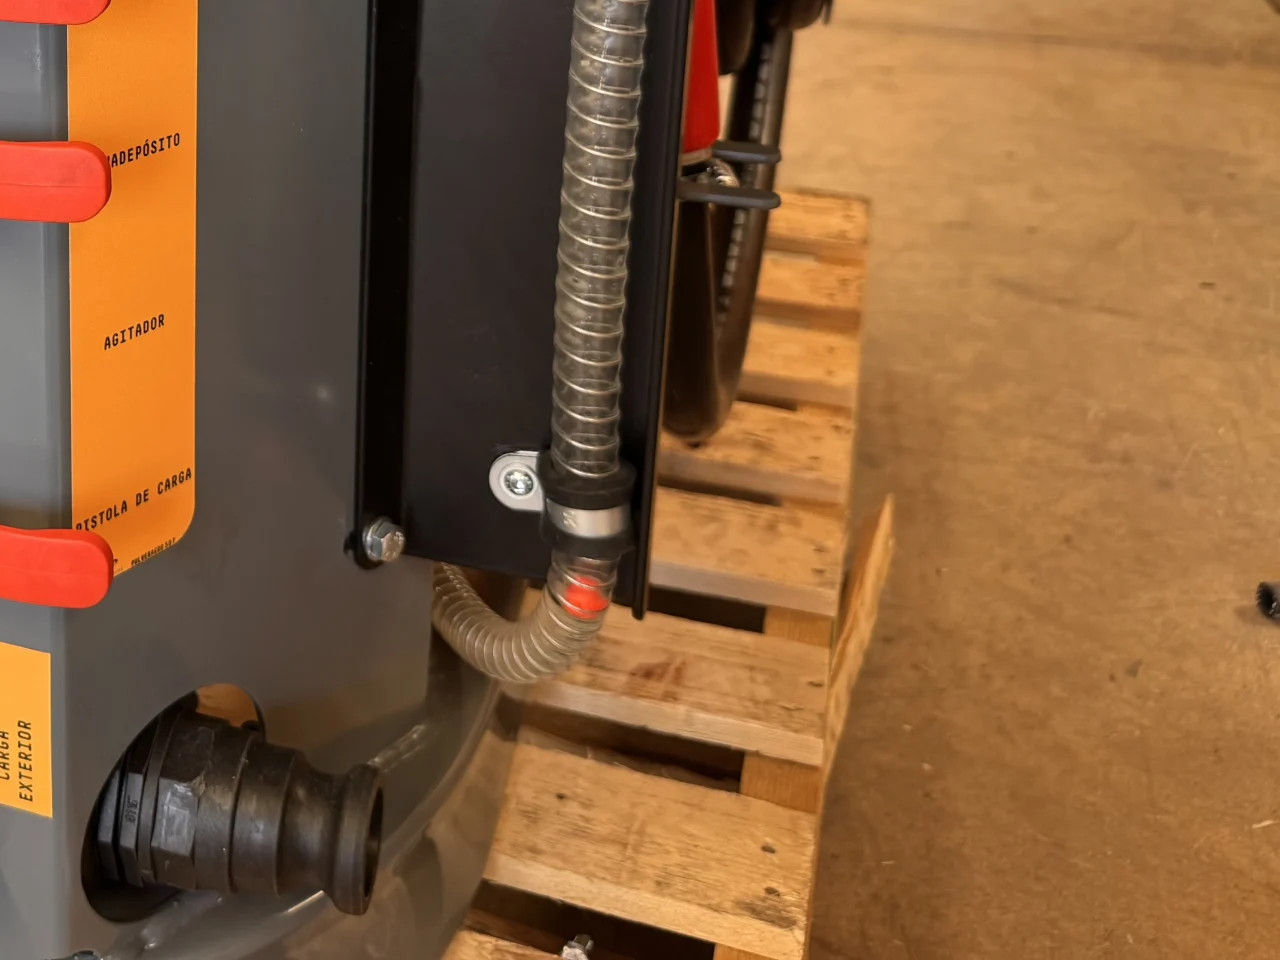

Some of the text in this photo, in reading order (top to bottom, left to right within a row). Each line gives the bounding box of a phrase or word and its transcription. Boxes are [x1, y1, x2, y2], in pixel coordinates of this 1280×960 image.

[107, 132, 180, 168] ADEPÓSITO
[104, 313, 165, 351] AGITADOR
[136, 488, 149, 506] DE
[157, 467, 192, 495] CARGA
[18, 720, 33, 802] EXTERIOR
